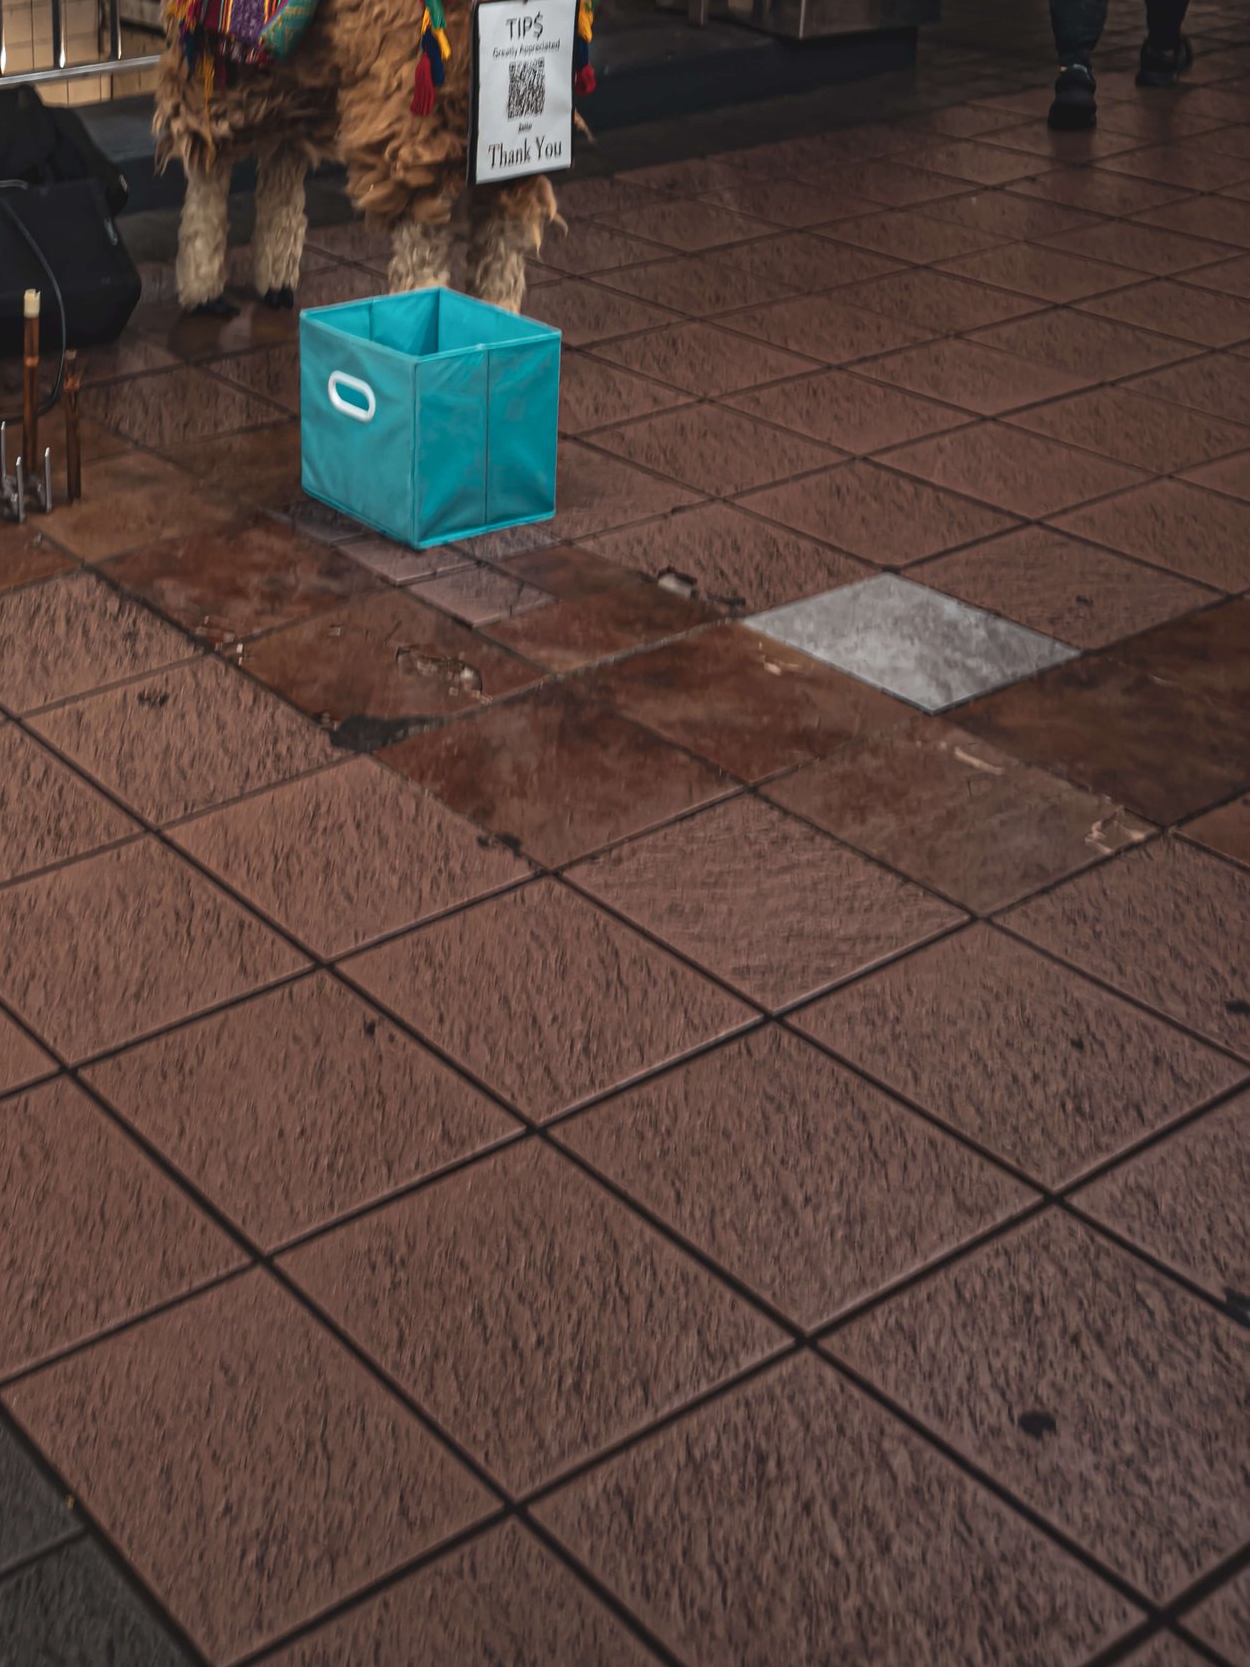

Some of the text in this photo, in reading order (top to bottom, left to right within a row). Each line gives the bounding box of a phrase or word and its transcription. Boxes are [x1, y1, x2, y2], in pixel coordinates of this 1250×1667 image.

[506, 11, 544, 41] TIP$
[488, 134, 562, 170] Thank You
